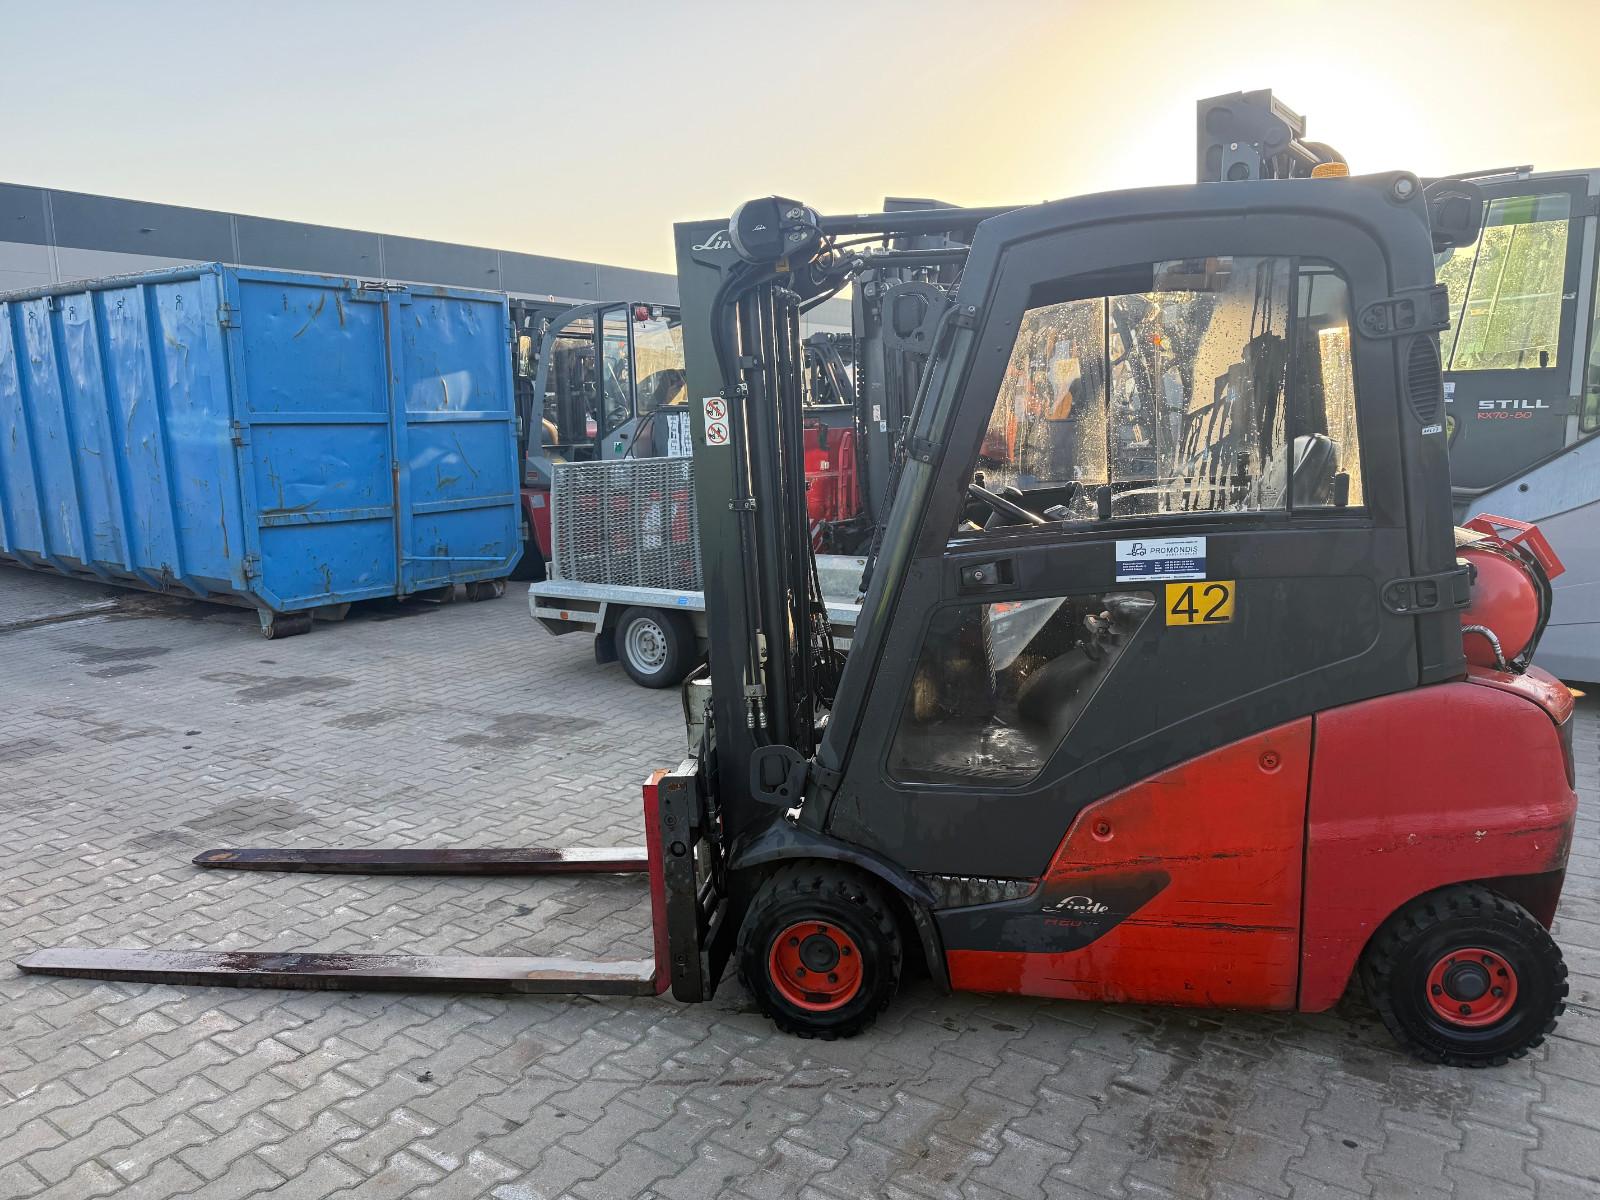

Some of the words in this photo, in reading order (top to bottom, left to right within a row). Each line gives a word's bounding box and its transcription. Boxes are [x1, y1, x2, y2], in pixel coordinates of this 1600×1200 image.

[692, 229, 731, 251] Lin
[1478, 399, 1550, 410] STILL
[1150, 545, 1198, 555] PROMONDIS
[1171, 584, 1230, 623] 42
[1041, 895, 1109, 914] Linde
